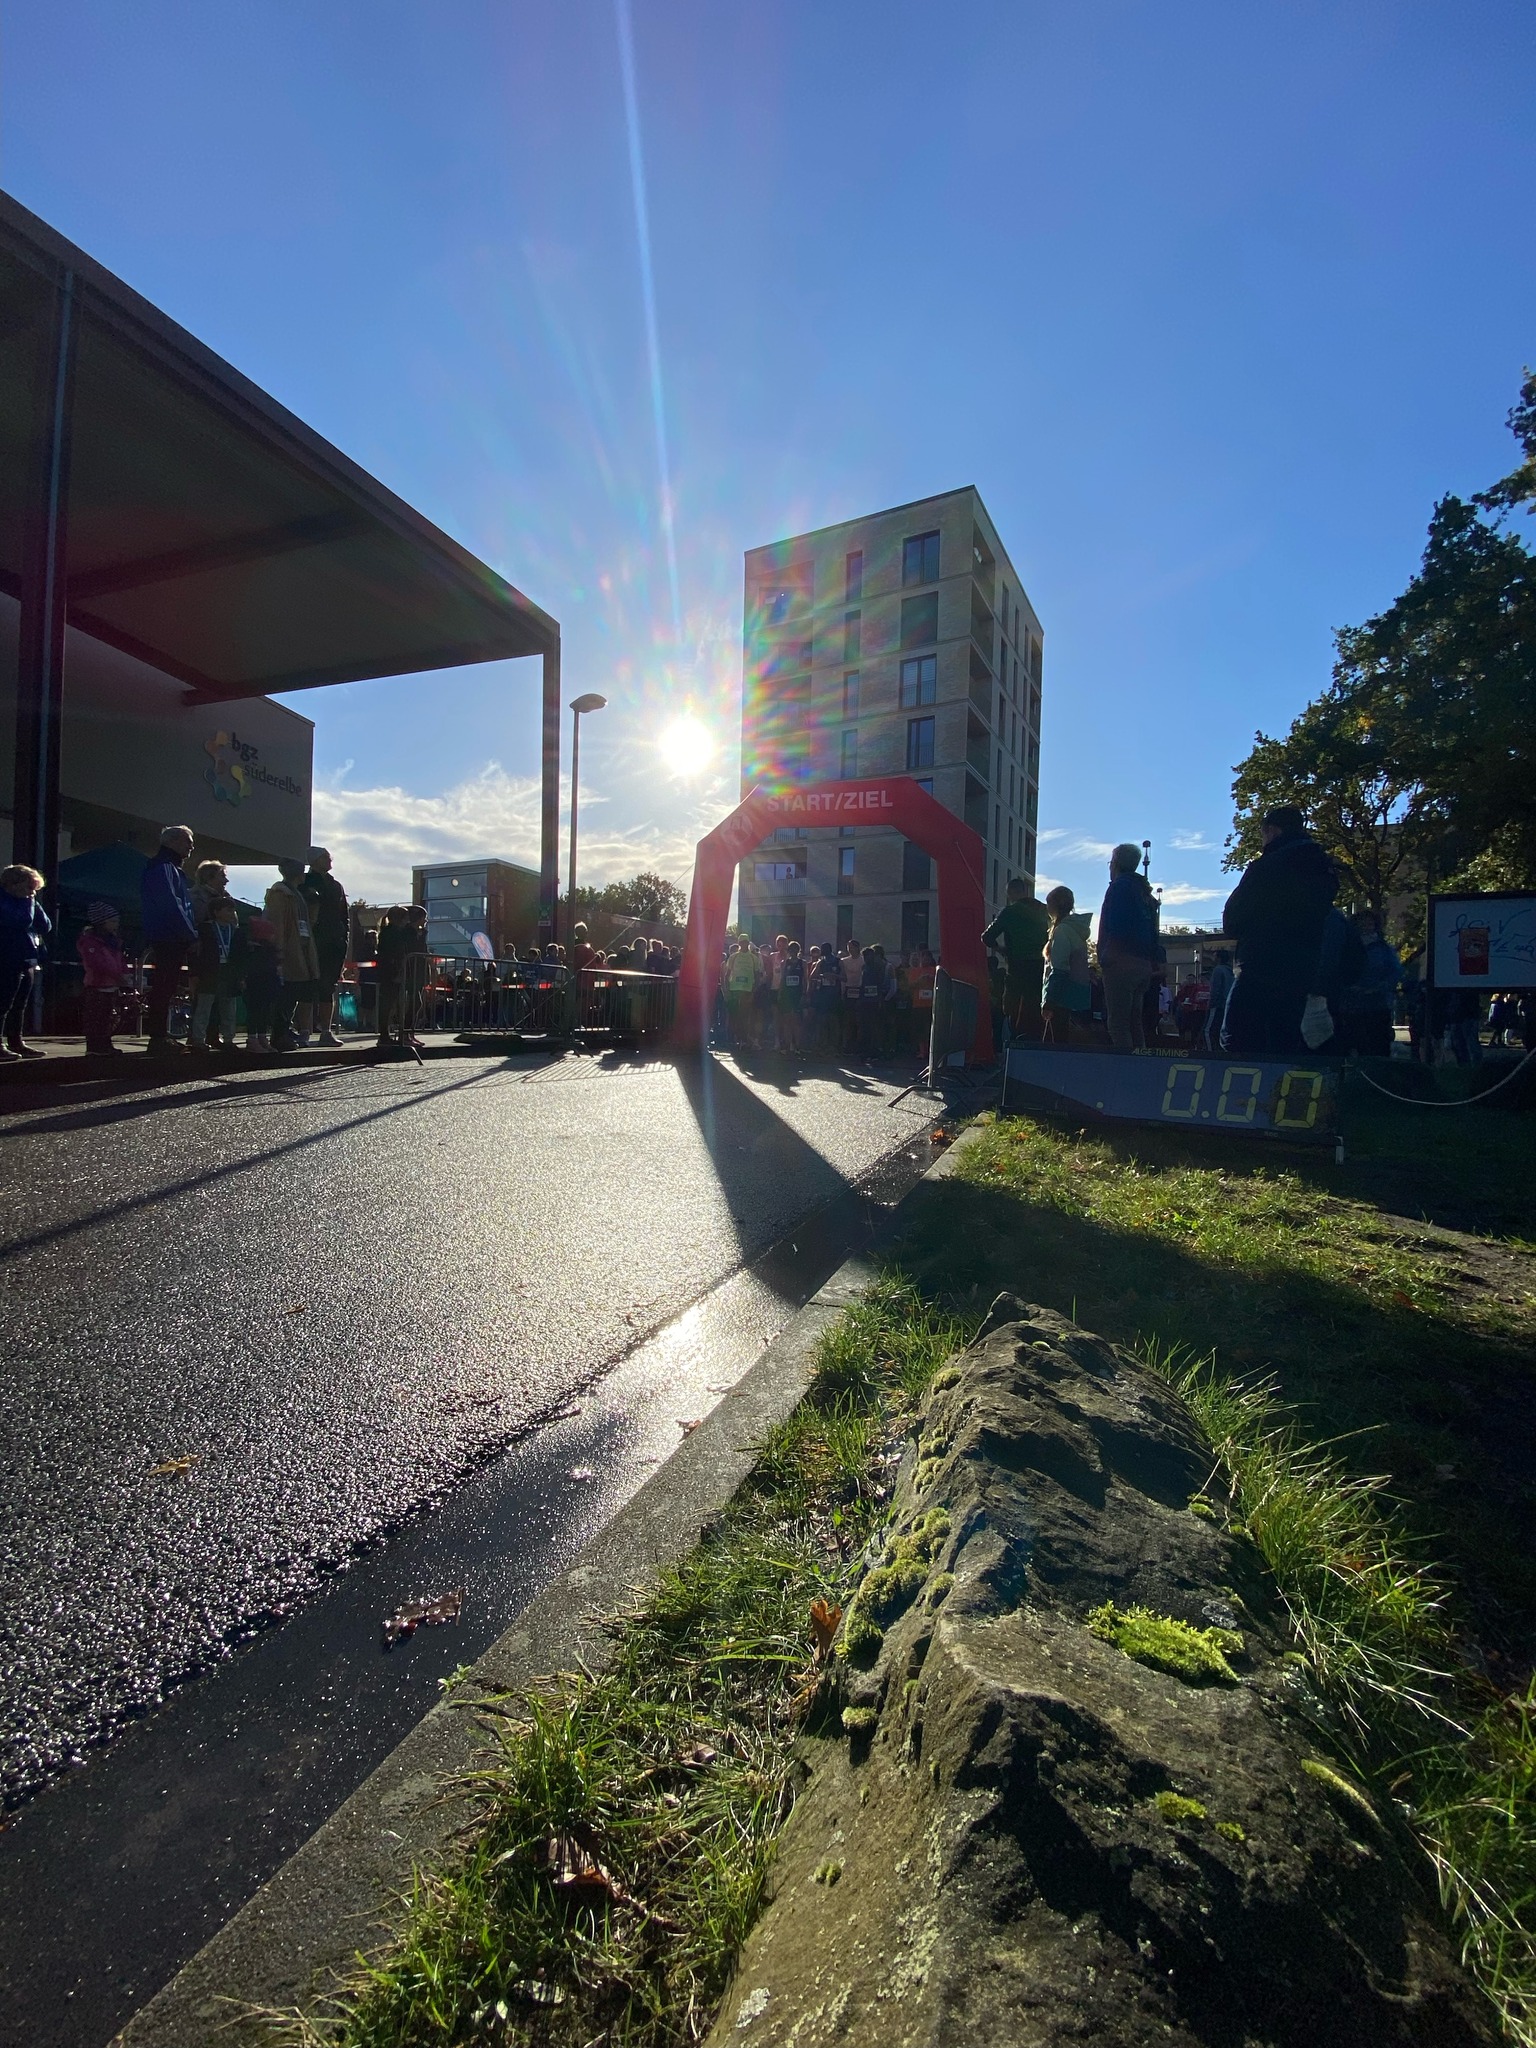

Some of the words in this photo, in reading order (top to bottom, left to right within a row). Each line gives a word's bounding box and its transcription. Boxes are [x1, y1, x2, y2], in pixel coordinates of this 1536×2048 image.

[231, 732, 259, 761] bgz
[243, 762, 303, 797] süderelbe
[766, 790, 894, 813] START/ZIEL
